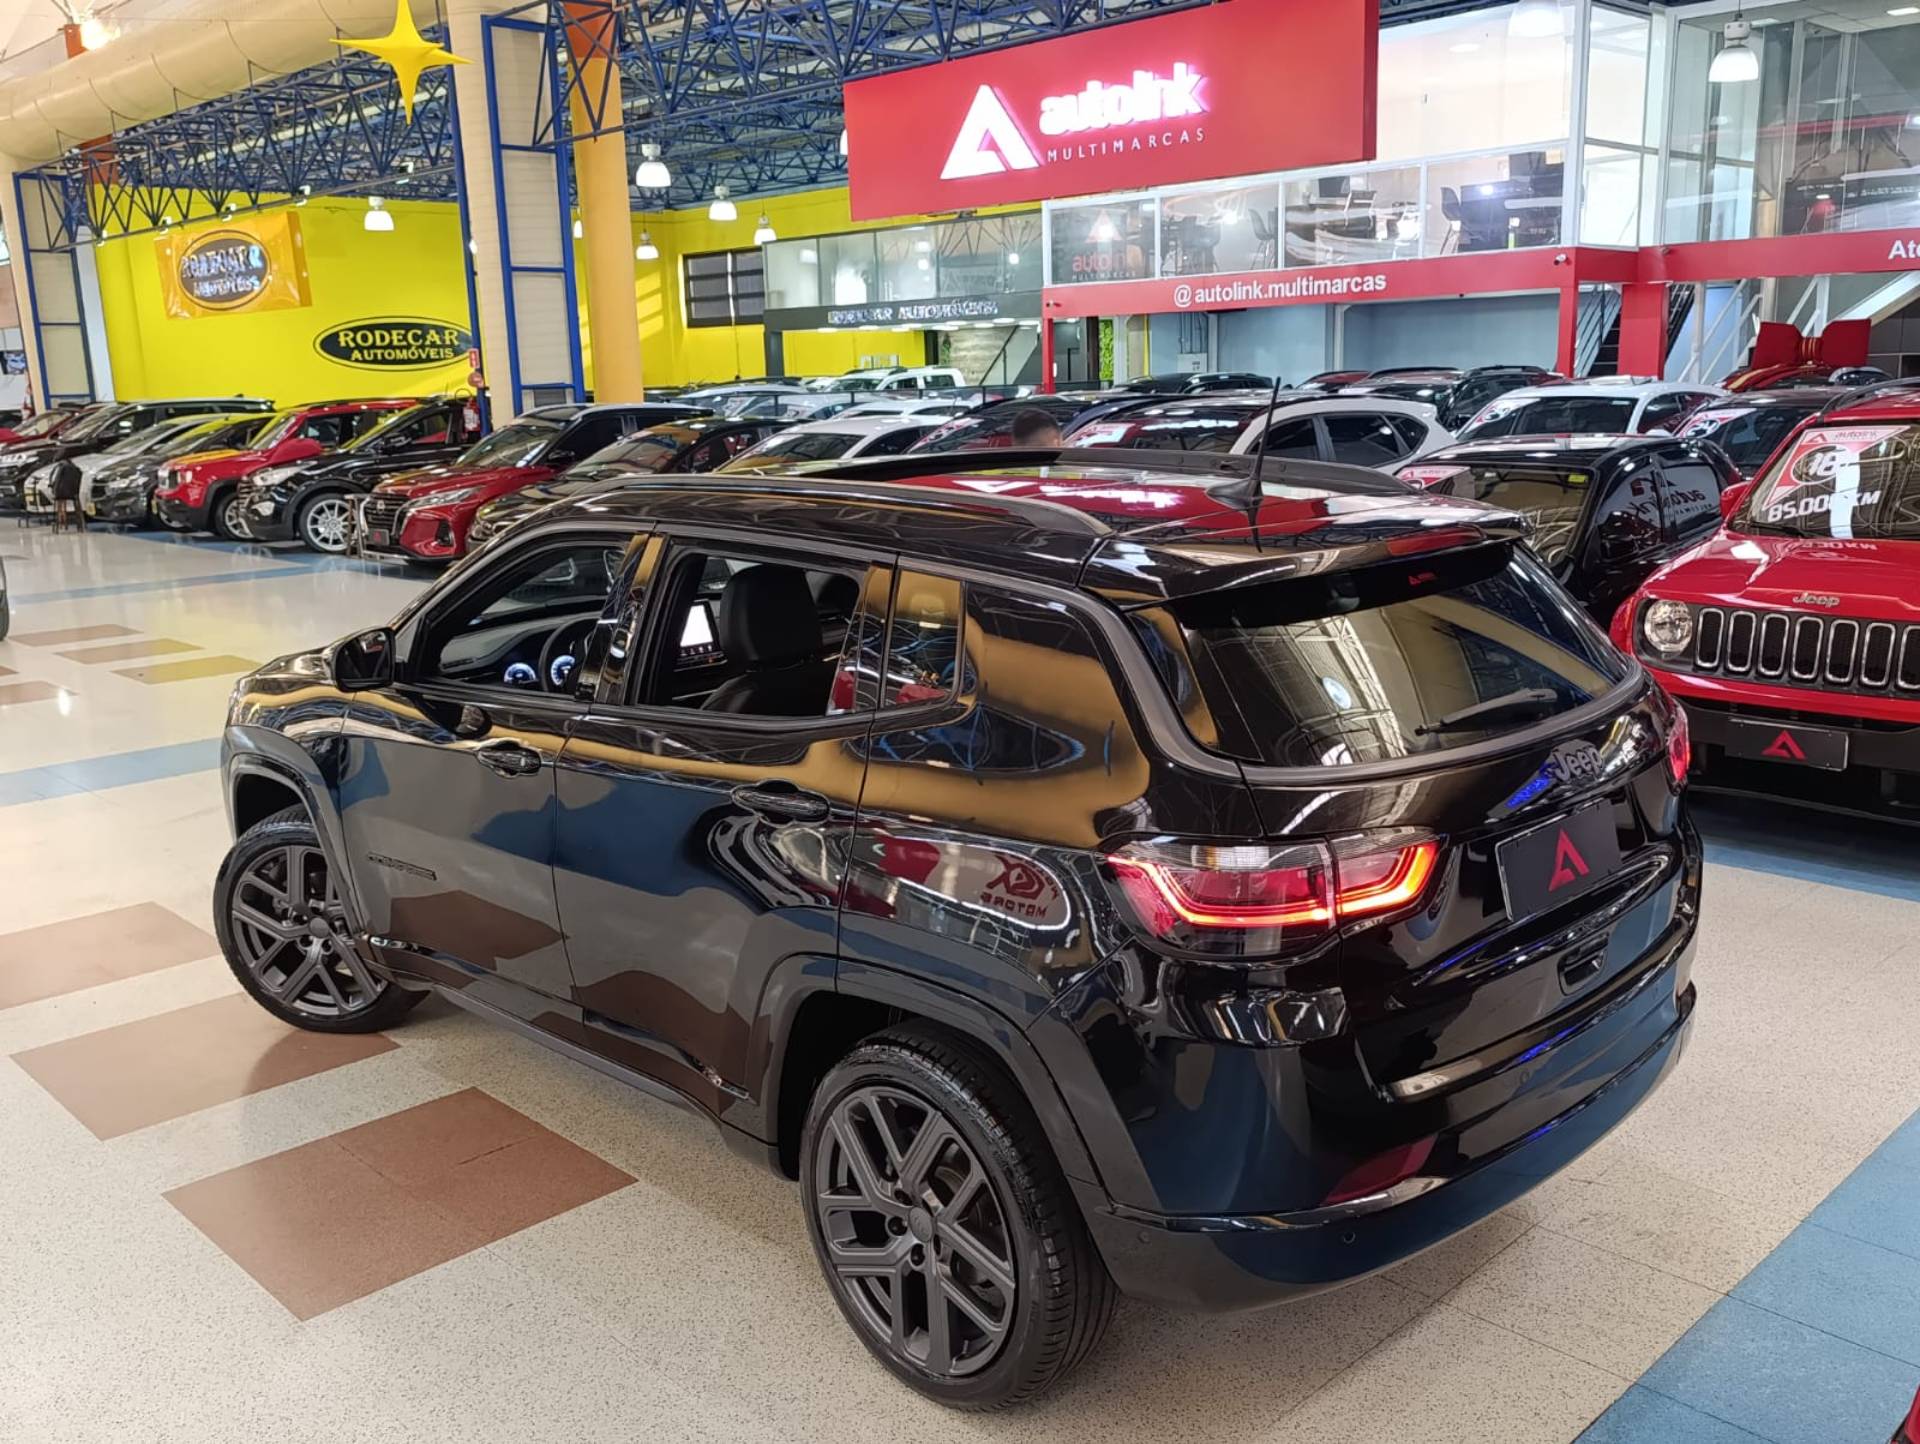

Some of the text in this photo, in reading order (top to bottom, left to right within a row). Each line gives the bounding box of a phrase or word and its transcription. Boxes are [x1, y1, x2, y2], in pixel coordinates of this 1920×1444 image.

[1038, 61, 1208, 136] autolink
[1047, 127, 1205, 163] MULTIMARCAS
[337, 328, 460, 348] RODECAR
[350, 345, 455, 362] AUTOMÓVEIS
[1792, 592, 1840, 608] Jeep
[1551, 745, 1604, 781] Jeep
